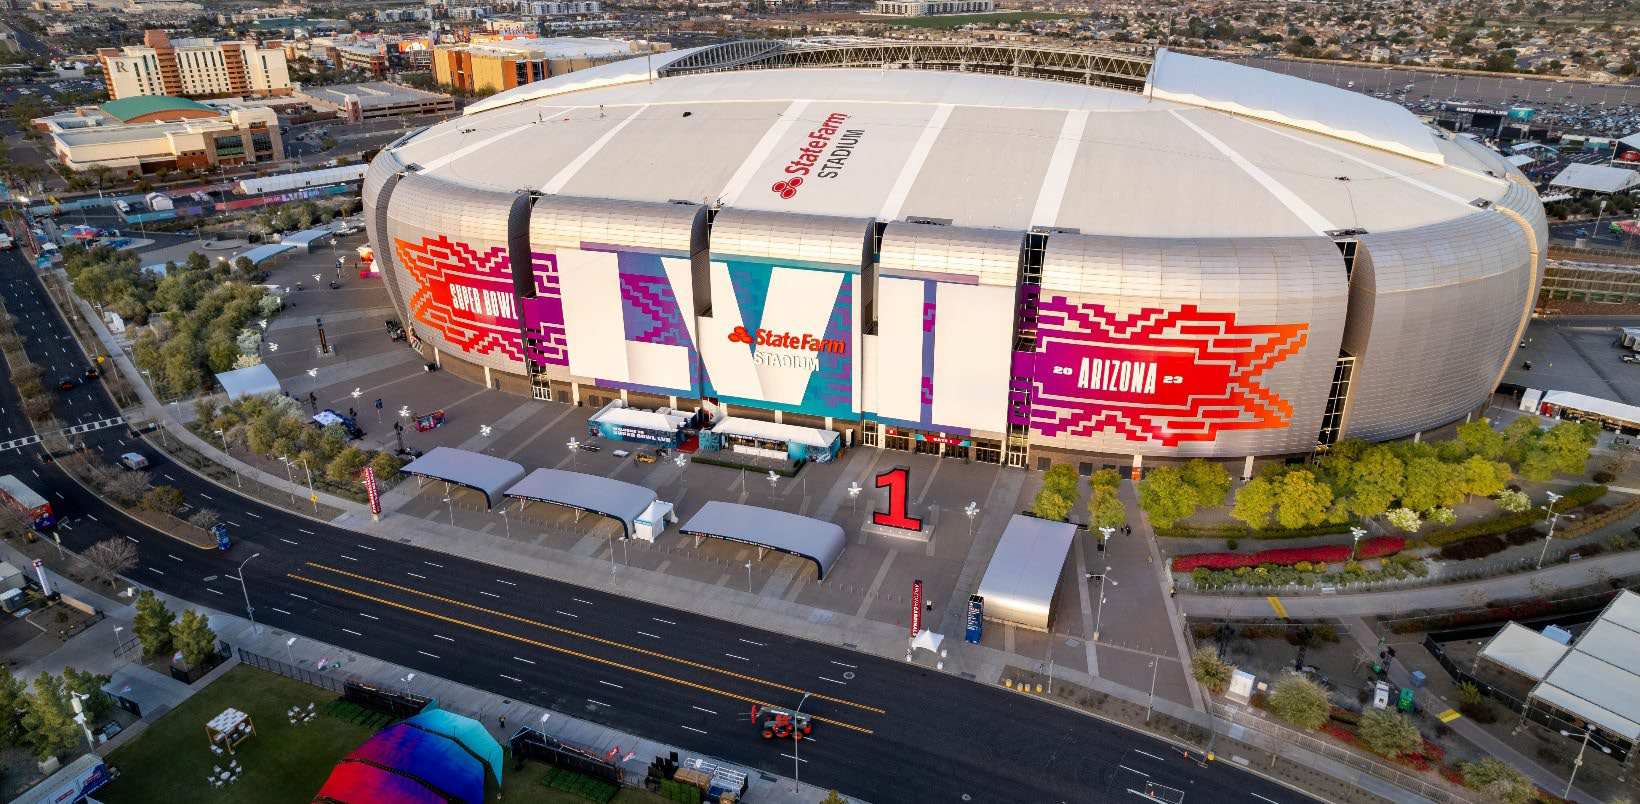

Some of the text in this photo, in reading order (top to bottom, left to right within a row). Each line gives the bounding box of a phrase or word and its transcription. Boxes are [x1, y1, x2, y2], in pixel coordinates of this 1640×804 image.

[115, 61, 129, 72] R
[817, 129, 865, 179] STADIUM
[449, 283, 519, 320] SUPER BOWL
[753, 351, 820, 372] STADIUM
[1053, 357, 1184, 394] 20 ARIZONA 23
[873, 467, 922, 532] 1
